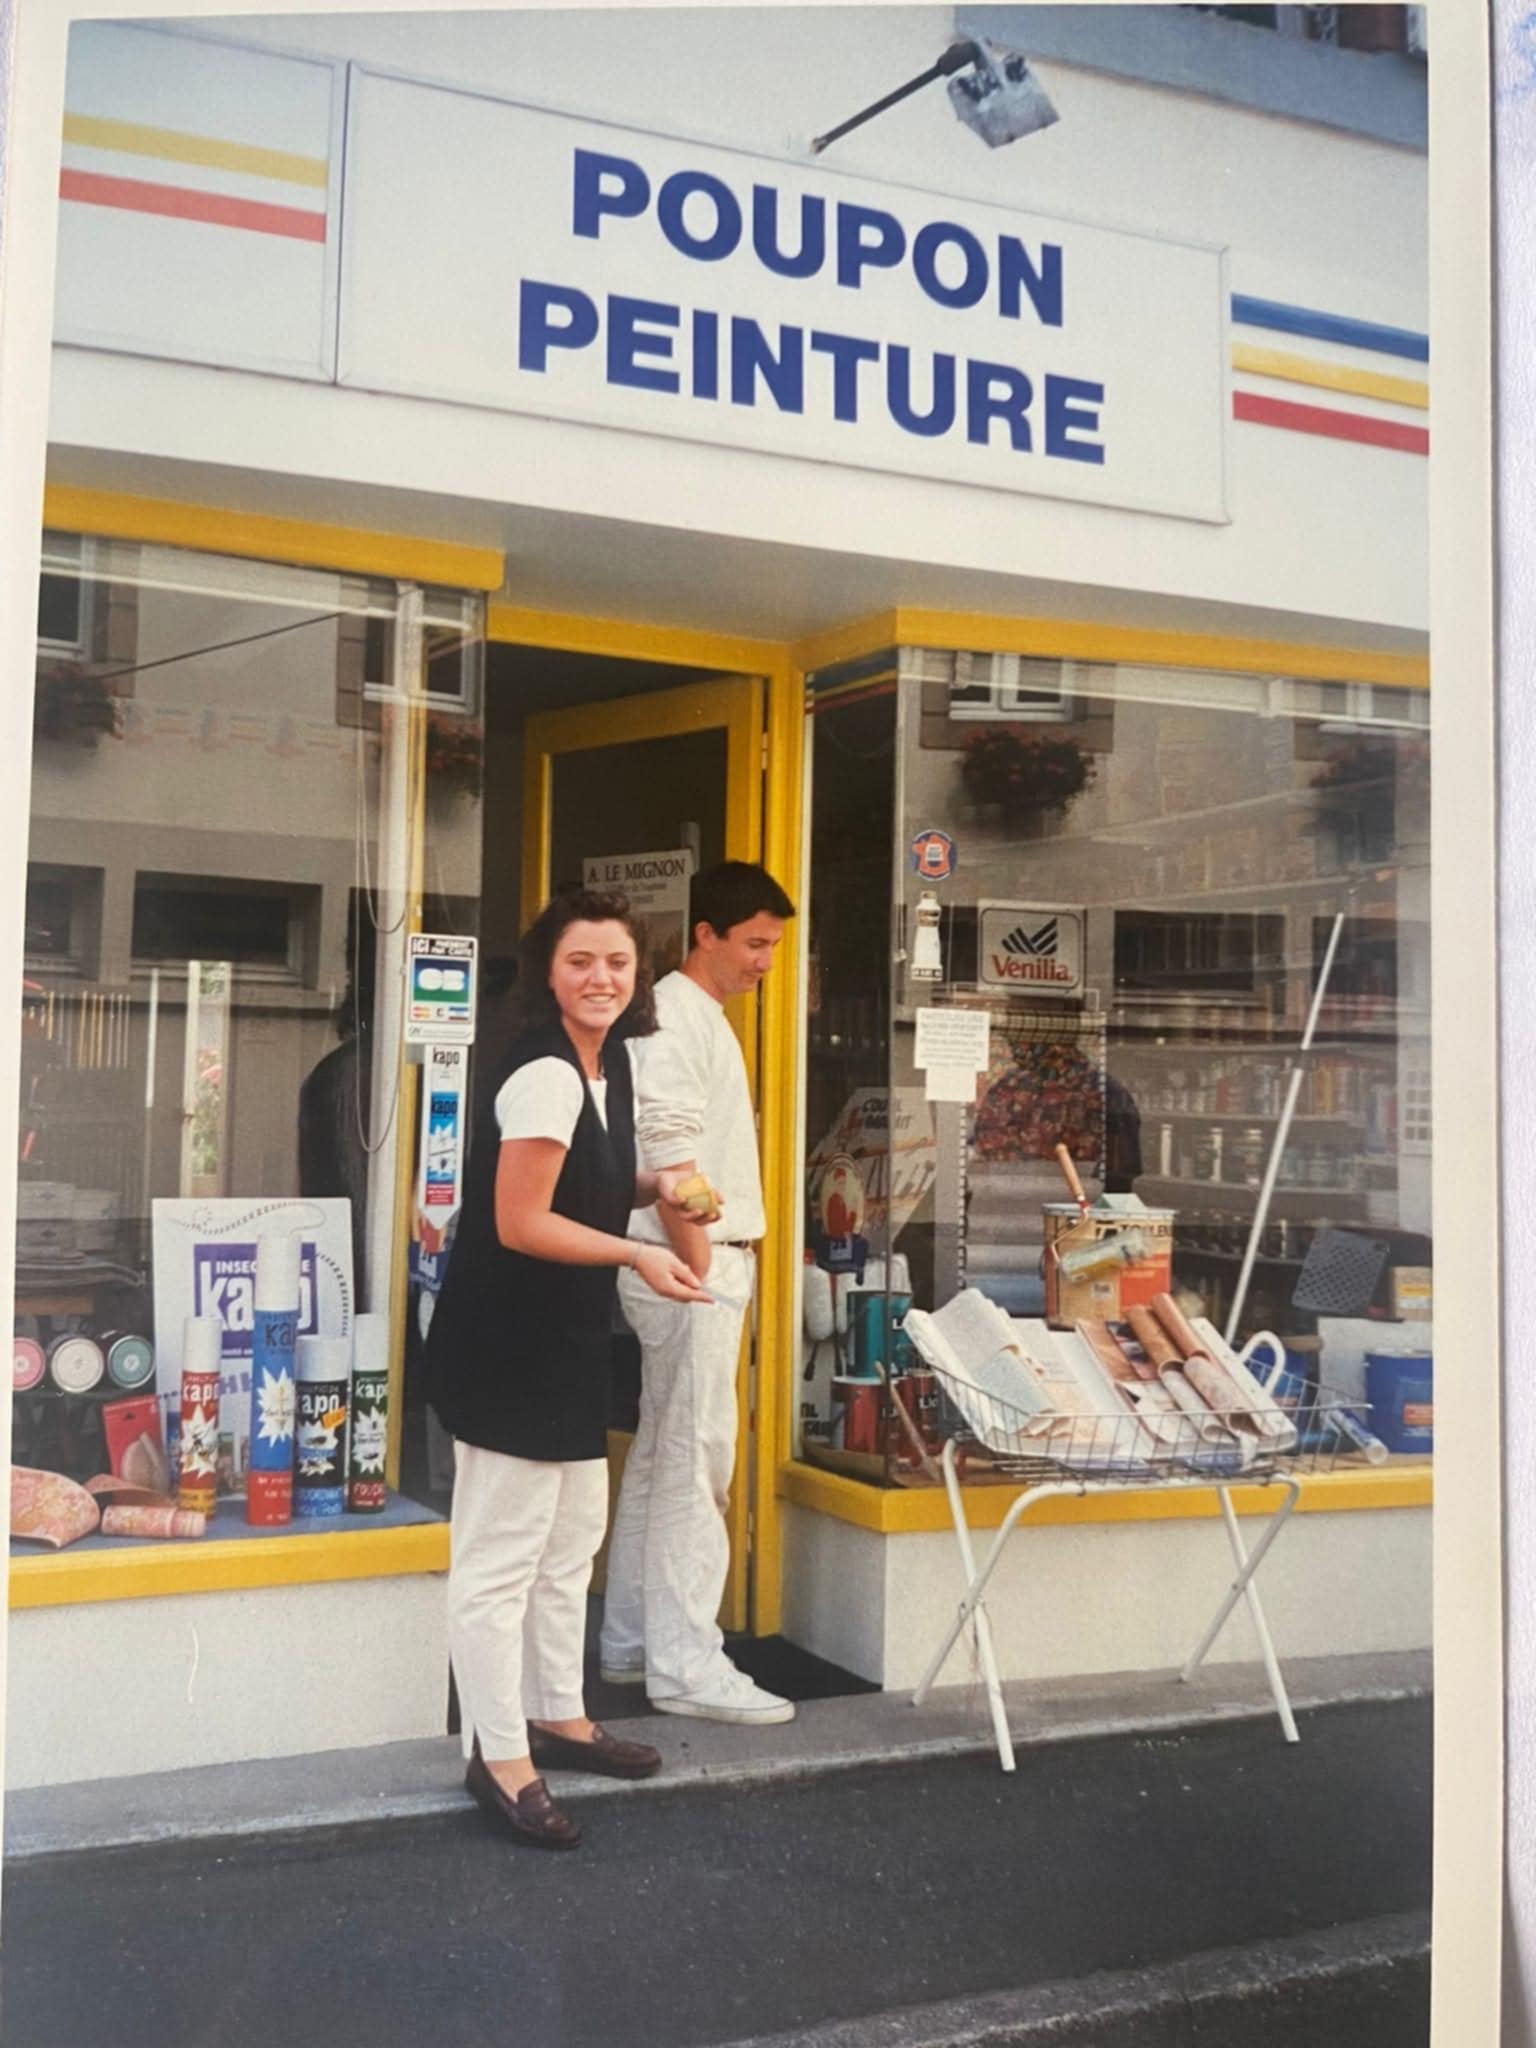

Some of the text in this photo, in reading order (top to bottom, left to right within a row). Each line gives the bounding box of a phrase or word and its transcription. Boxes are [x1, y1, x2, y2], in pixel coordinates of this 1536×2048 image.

[573, 148, 1063, 328] POUPON
[519, 278, 1105, 466] PEINTURE
[605, 864, 621, 881] LE
[624, 859, 686, 881] MIGNON
[432, 1045, 460, 1068] kapo
